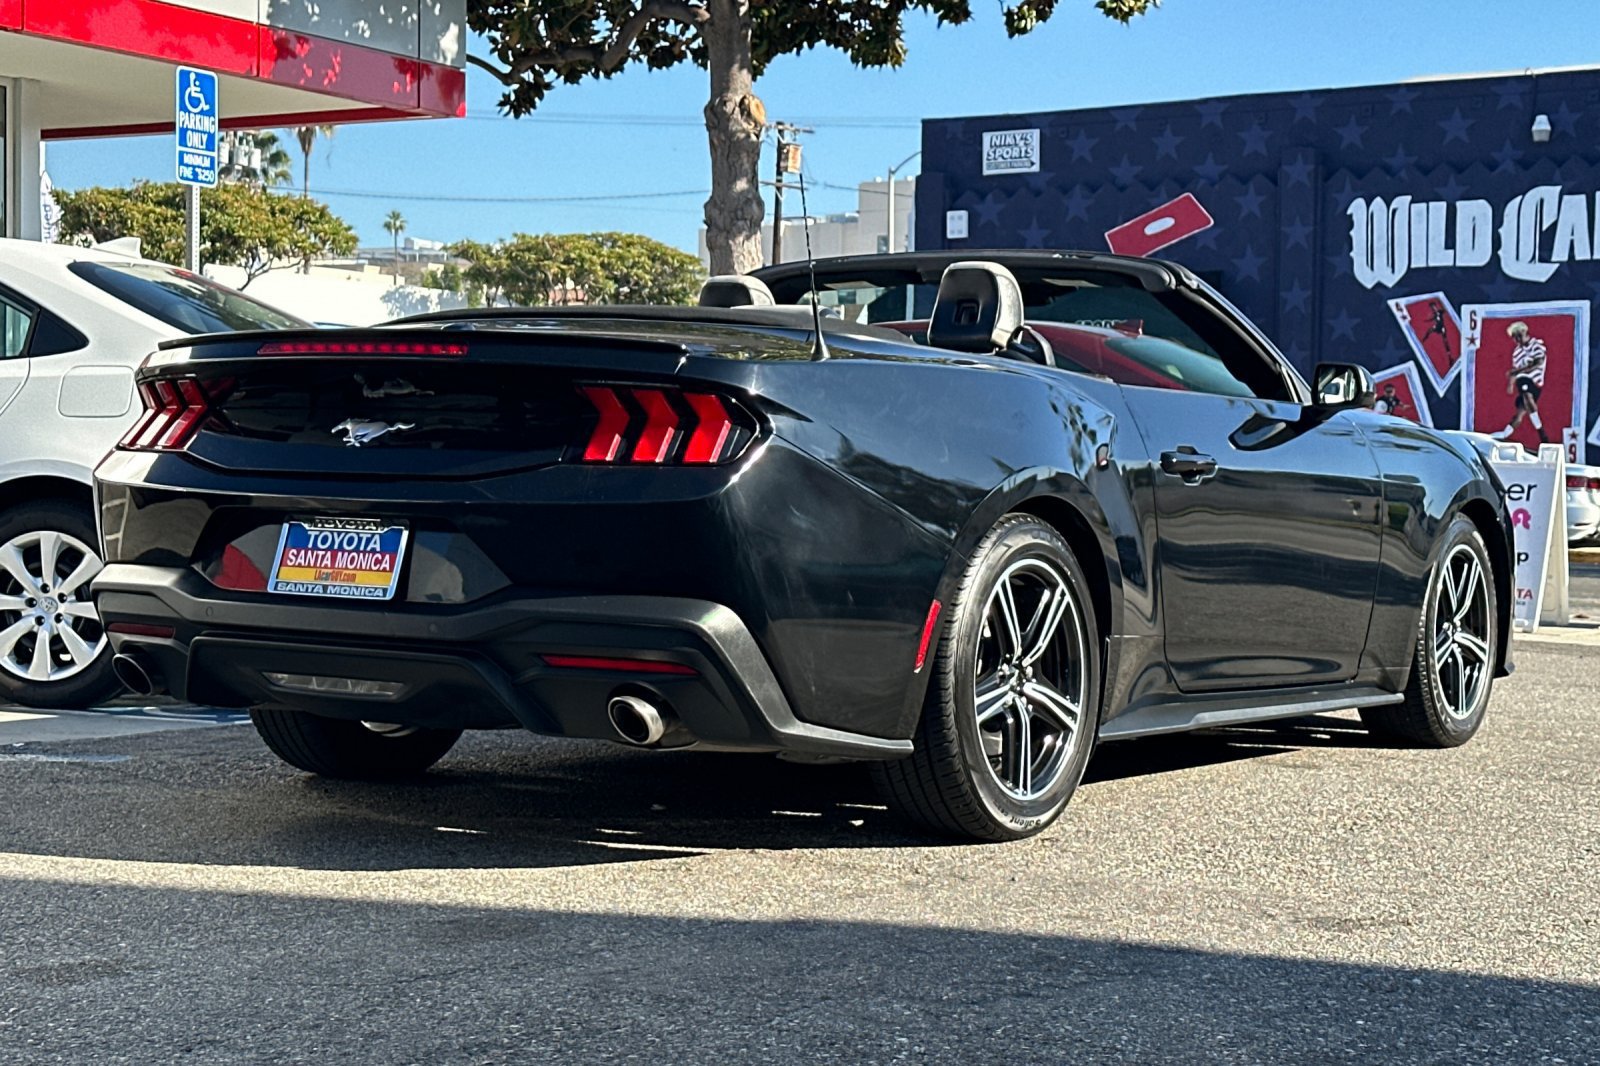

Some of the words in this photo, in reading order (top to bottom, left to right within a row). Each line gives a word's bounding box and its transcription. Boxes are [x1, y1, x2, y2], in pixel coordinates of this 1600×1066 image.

[180, 111, 215, 134] PARKING
[186, 130, 208, 149] ONLY
[990, 133, 1033, 148] NIKY'S
[183, 153, 211, 168] MINIMUM
[986, 147, 1033, 161] SPORTS
[1346, 195, 1493, 289] WILD
[1497, 185, 1600, 283] CA
[1469, 310, 1477, 331] 6
[307, 531, 381, 552] TOYOTA
[286, 548, 332, 568] SANTA
[335, 551, 390, 571] MONICA
[277, 582, 324, 595] SANTA
[326, 585, 383, 597] MONICA
